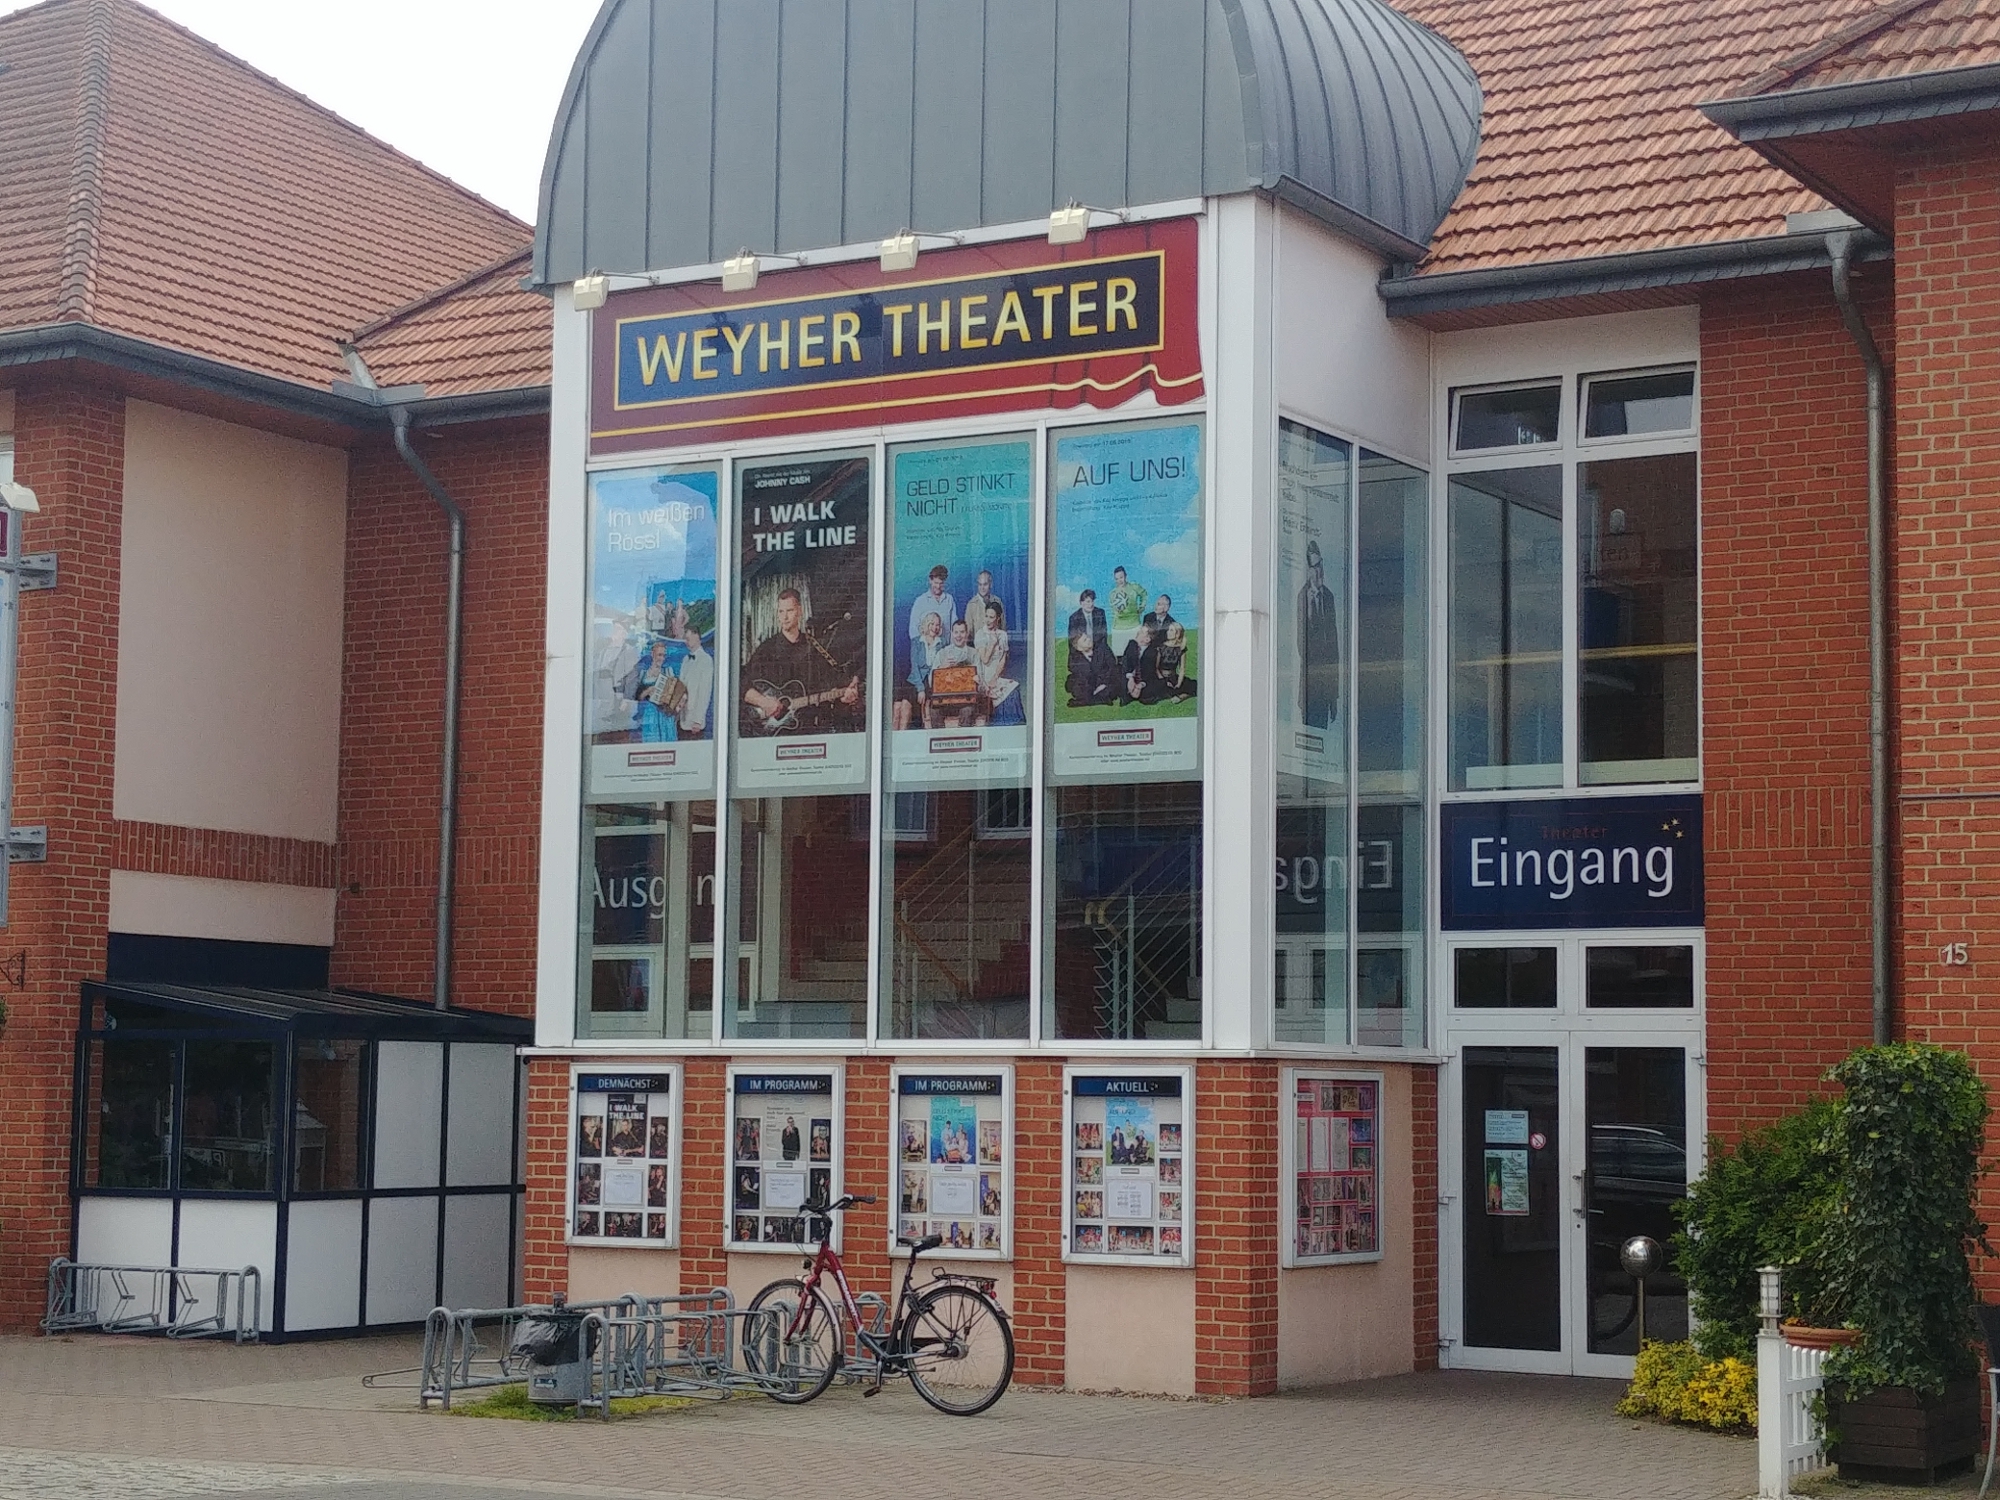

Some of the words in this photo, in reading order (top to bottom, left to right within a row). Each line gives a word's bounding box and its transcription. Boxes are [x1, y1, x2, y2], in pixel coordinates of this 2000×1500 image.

[637, 311, 862, 386] WEYHER
[883, 277, 1138, 357] THEATER
[754, 478, 788, 489] JOHNNY
[789, 475, 811, 486] CASH
[906, 478, 950, 497] GELD
[956, 472, 1016, 493] STINKT
[1073, 462, 1120, 488] AUF
[1130, 456, 1185, 483] UNS!
[608, 509, 632, 528] Im
[638, 502, 705, 526] weißen
[754, 507, 761, 526] I
[770, 500, 836, 525] WALK
[907, 498, 958, 517] NICHT
[608, 528, 660, 553] Rössl
[753, 530, 796, 553] THE
[805, 525, 857, 548] LINE
[1471, 837, 1673, 899] Eingang
[1941, 942, 1968, 965] 15
[598, 1077, 651, 1089] DEMNÄCHST
[749, 1080, 762, 1090] IM
[764, 1080, 818, 1091] PROGRAMM
[914, 1080, 928, 1091] IM
[930, 1080, 987, 1091] PROGRAMM
[1105, 1081, 1150, 1093] AKTUELL
